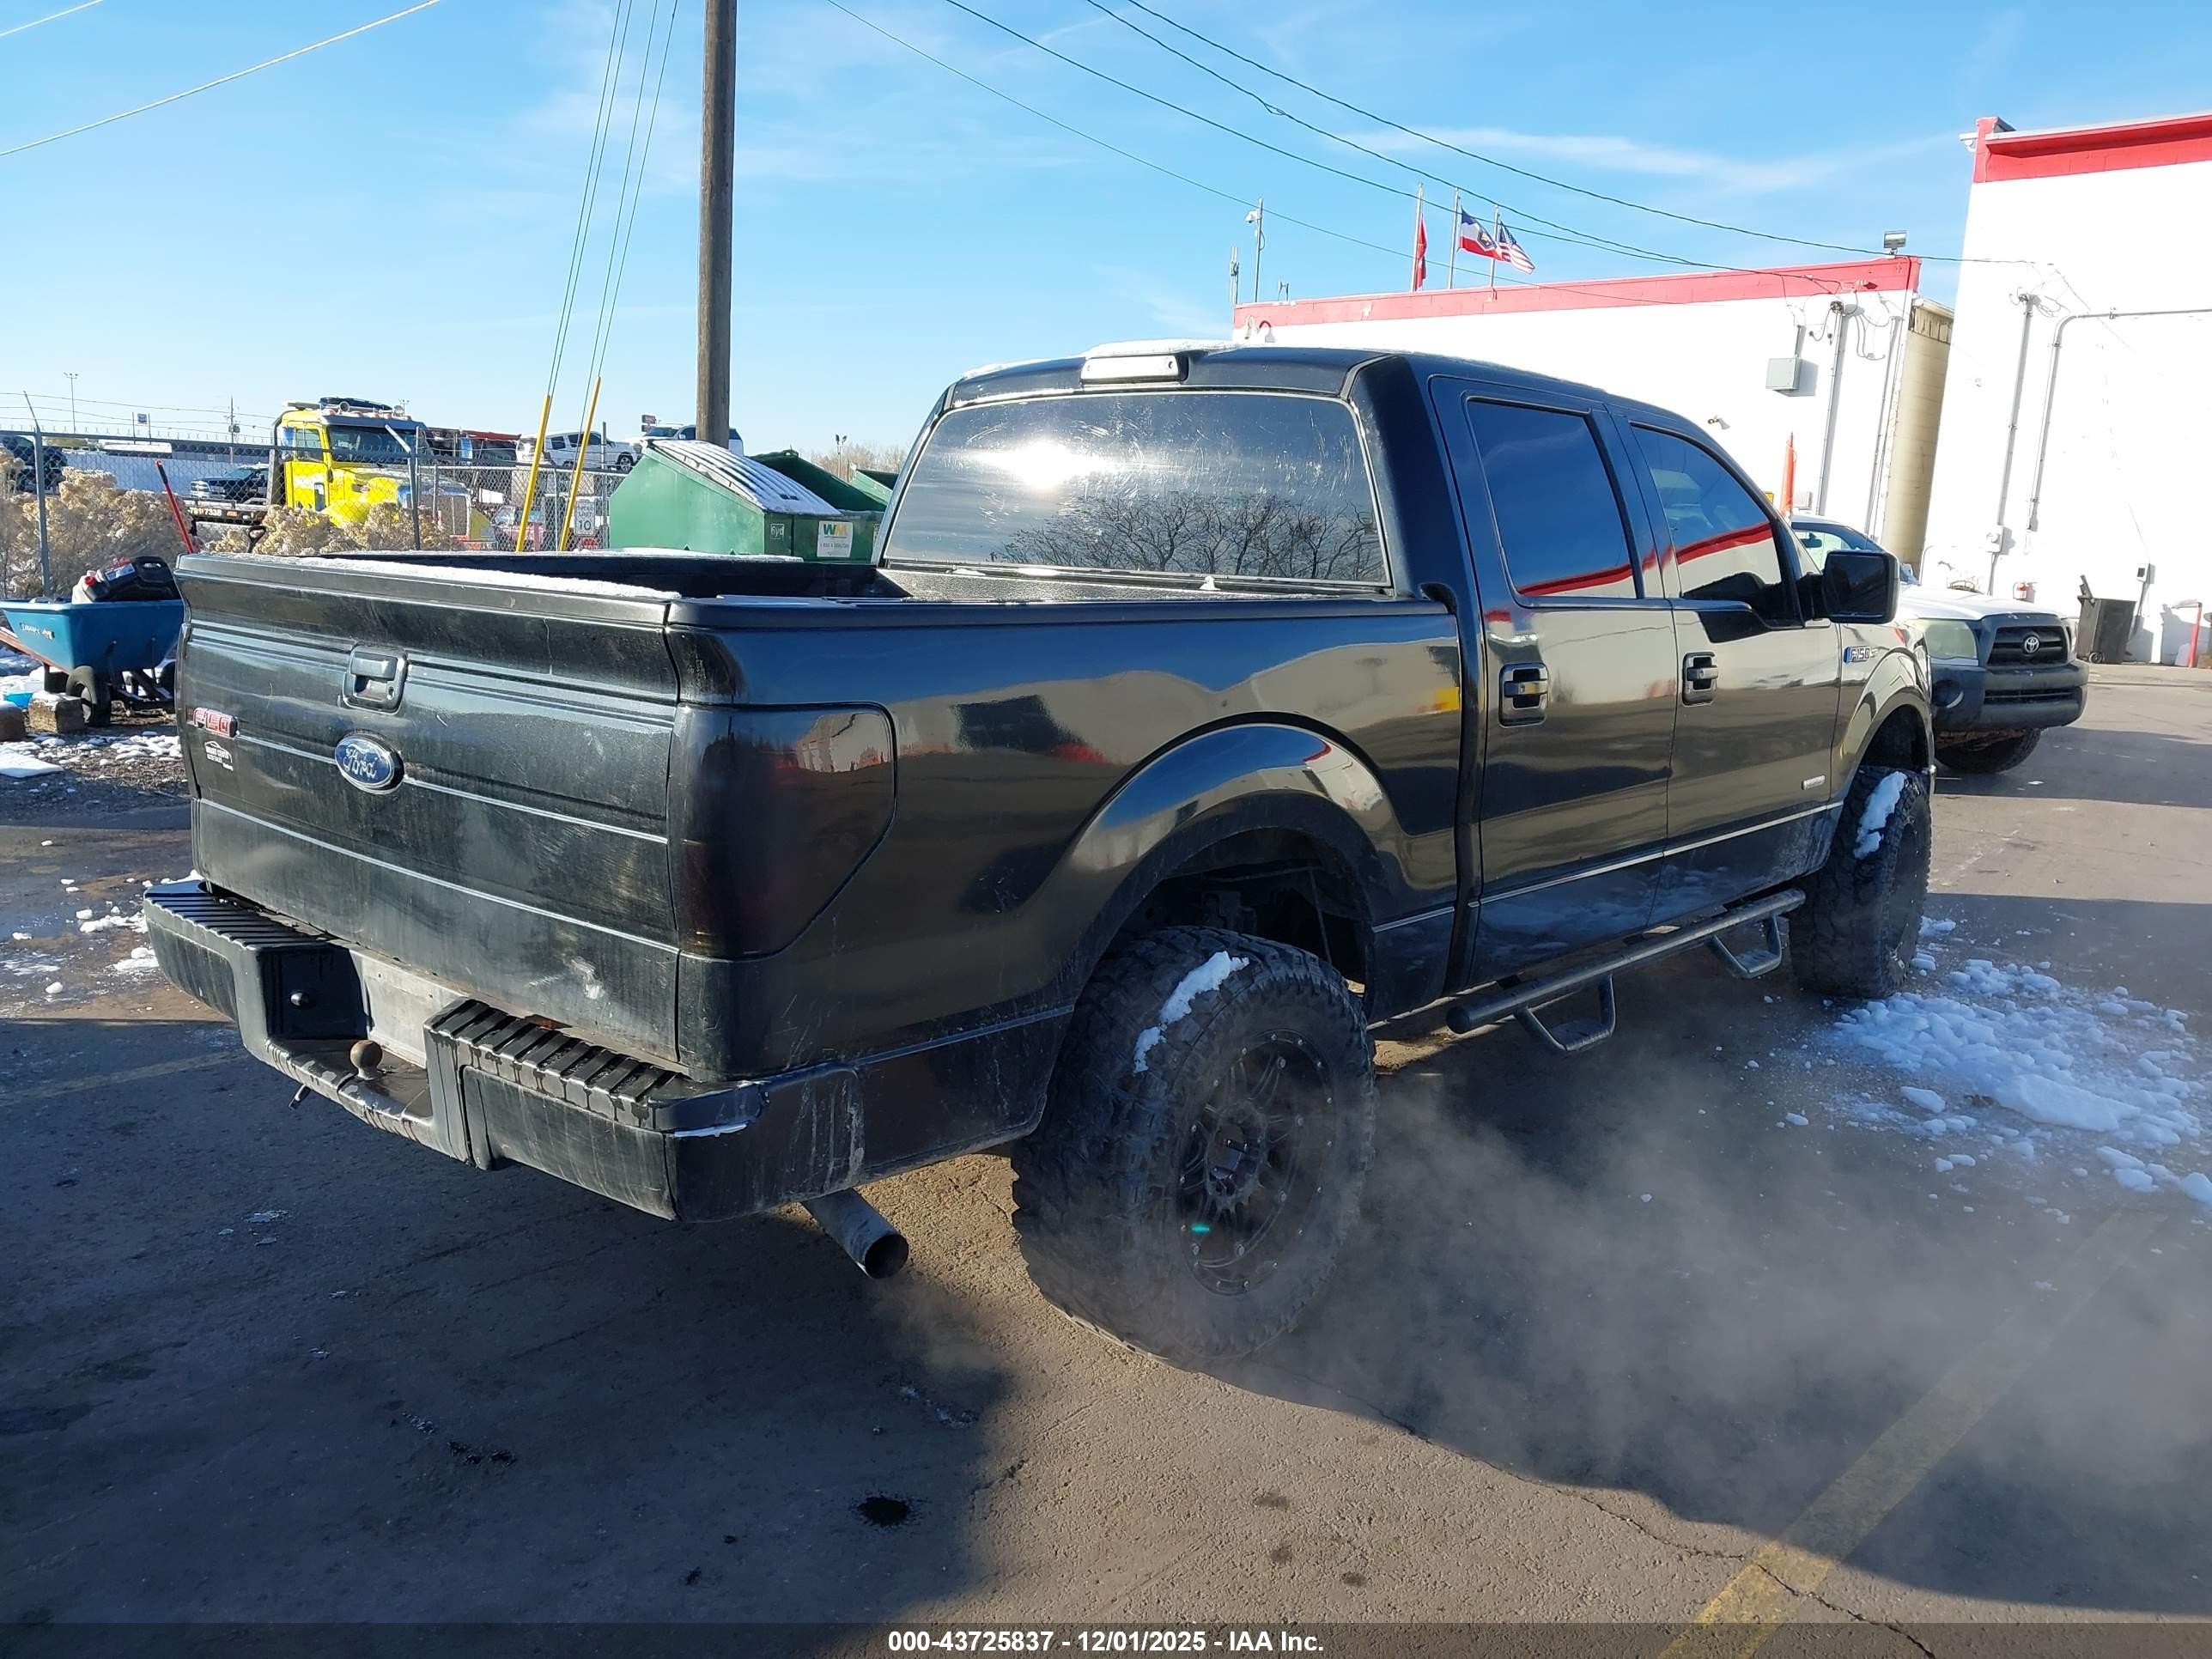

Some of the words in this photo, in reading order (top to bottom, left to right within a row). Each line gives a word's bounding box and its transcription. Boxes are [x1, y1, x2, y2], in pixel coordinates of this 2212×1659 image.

[578, 520, 592, 531] 10
[823, 524, 848, 537] WM
[343, 744, 380, 780] Ford
